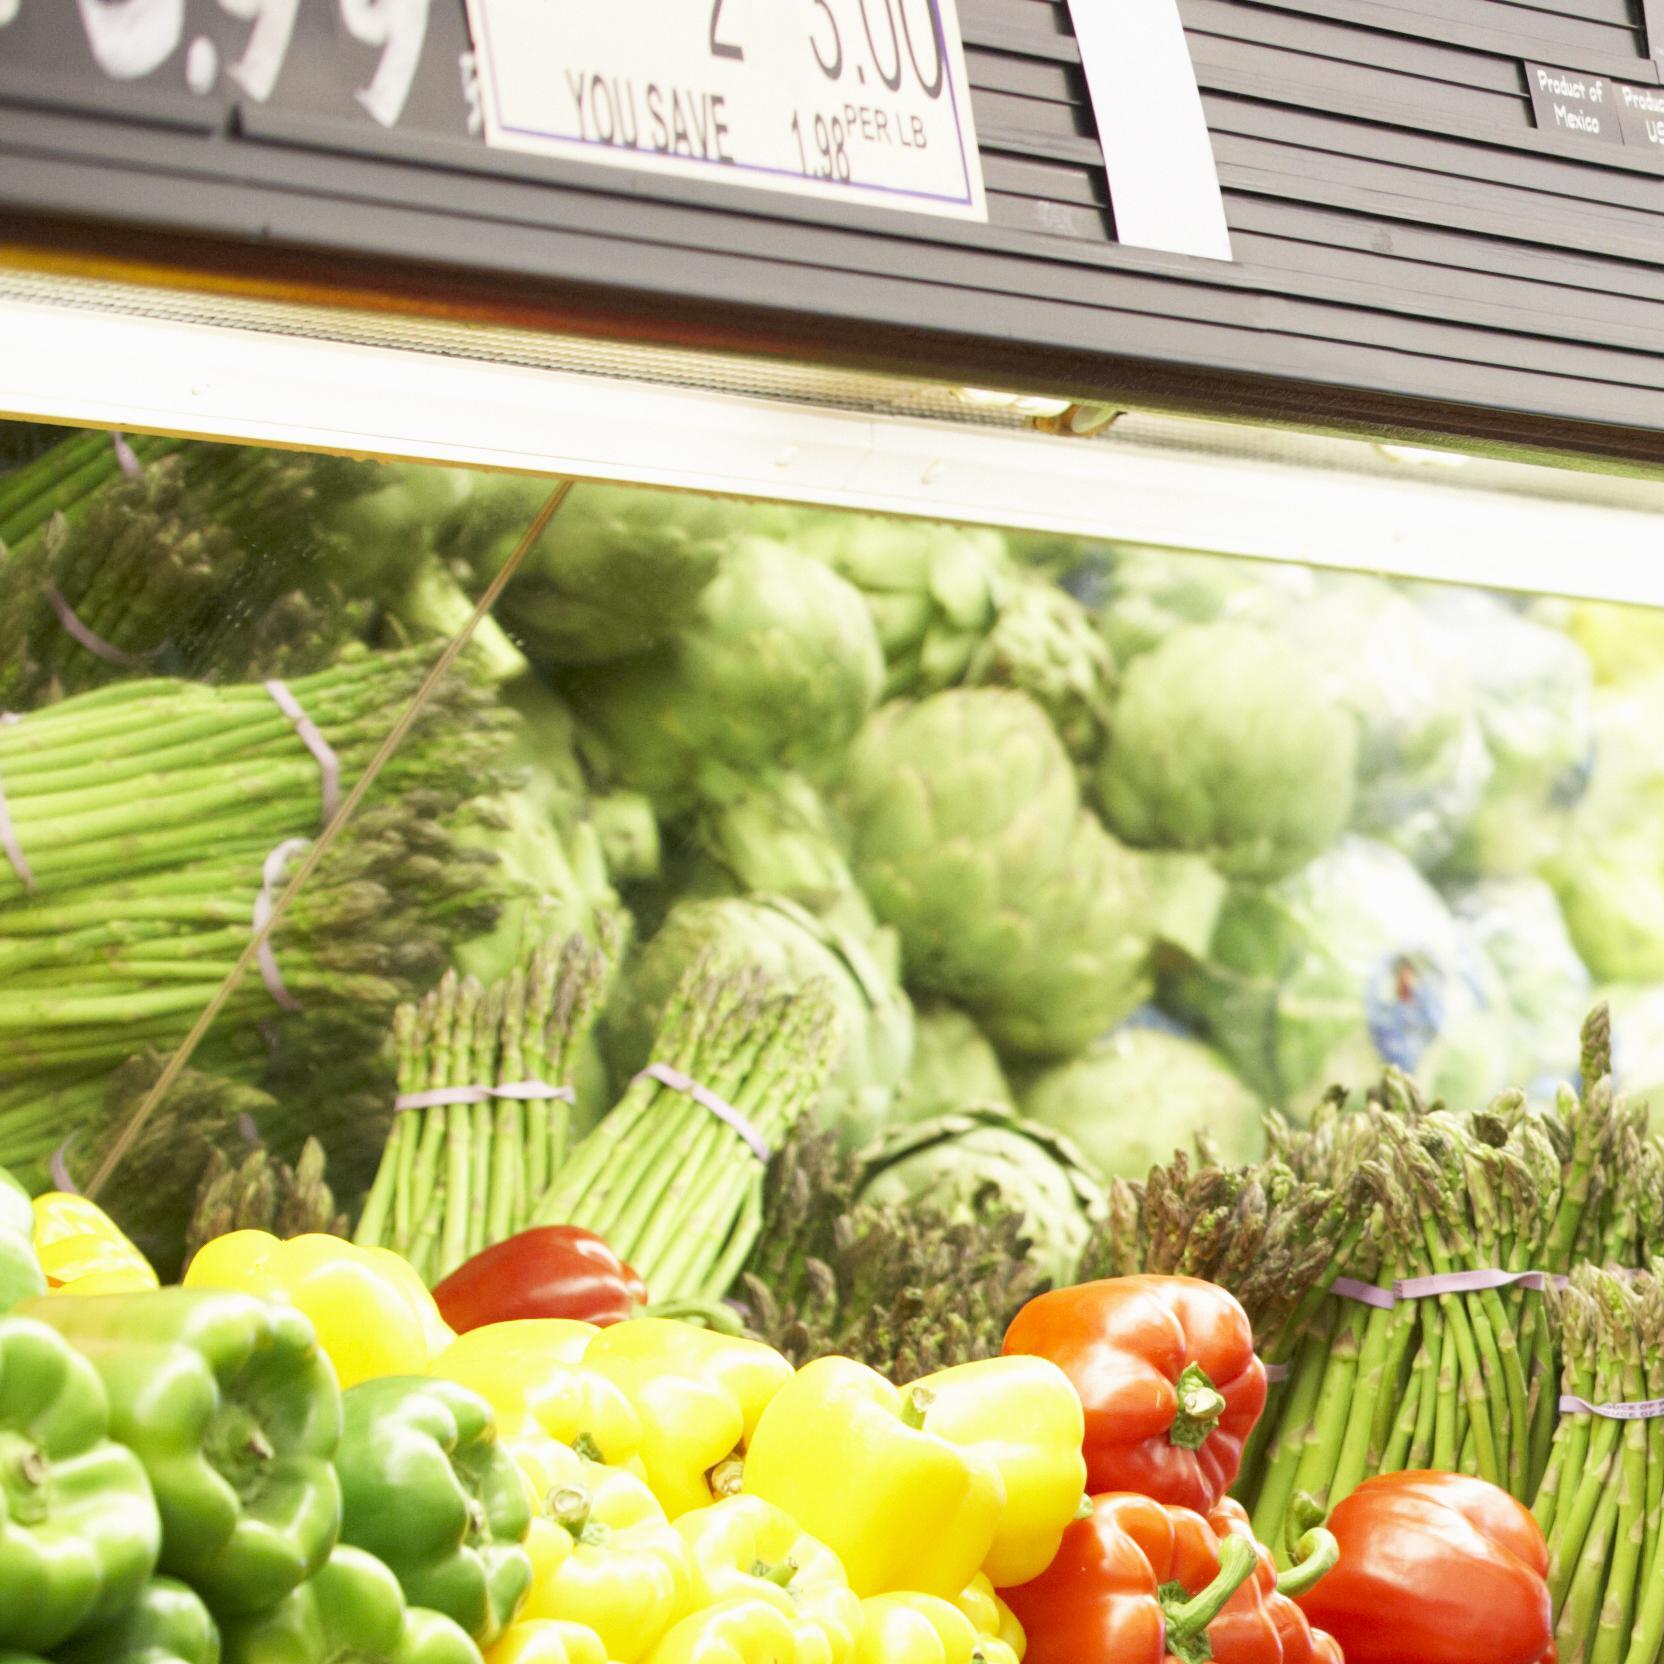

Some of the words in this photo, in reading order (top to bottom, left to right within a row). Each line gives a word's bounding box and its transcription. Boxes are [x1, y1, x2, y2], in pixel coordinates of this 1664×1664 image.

[1537, 69, 1585, 99] Product
[1589, 80, 1603, 103] of
[566, 69, 640, 149] YOU
[646, 83, 735, 164] SAVE
[791, 108, 852, 185] 1.98
[844, 103, 892, 144] PER
[898, 112, 928, 150] LB
[1553, 103, 1600, 134] Mexico
